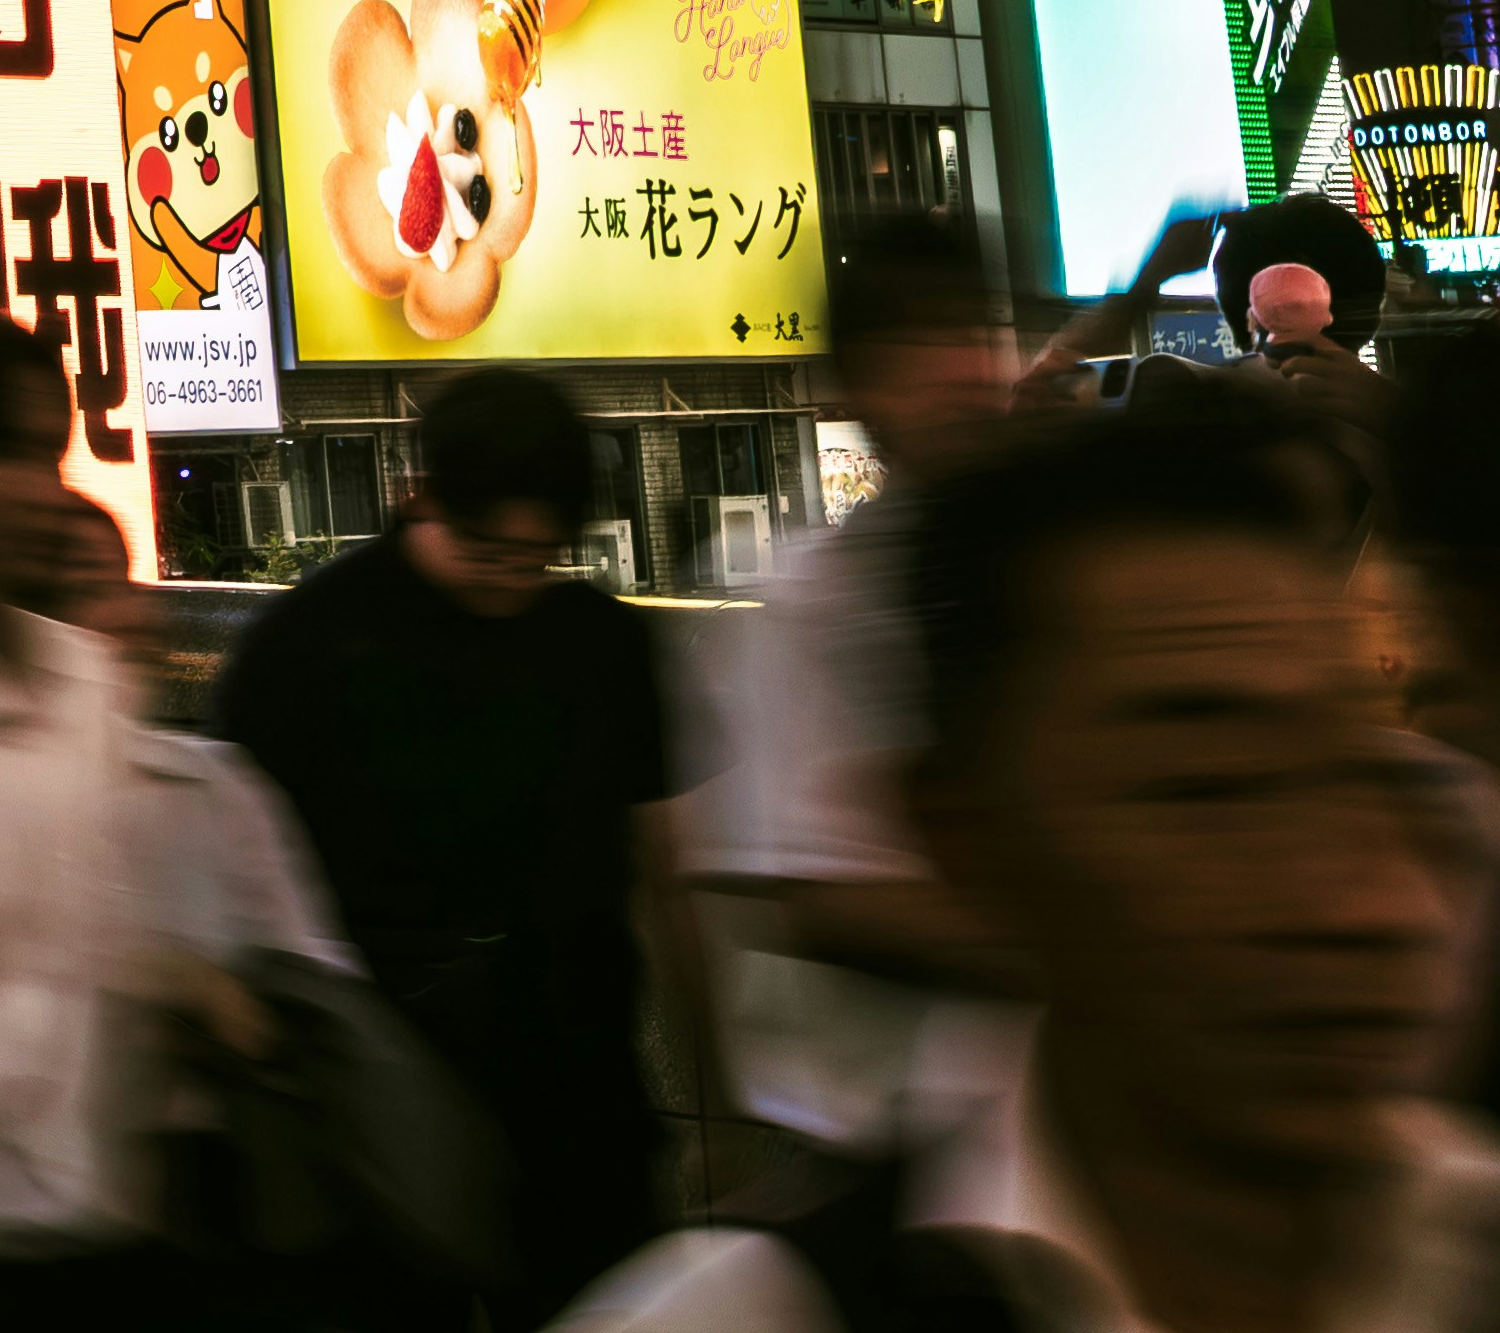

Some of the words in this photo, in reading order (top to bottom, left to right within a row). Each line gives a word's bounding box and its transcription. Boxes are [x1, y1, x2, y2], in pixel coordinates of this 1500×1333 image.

[569, 108, 690, 162] 大阪土産
[578, 195, 631, 241] 大阪
[635, 177, 809, 263] 花ラング
[144, 332, 258, 369] www.jsv.jp
[145, 378, 264, 406] 06-4963-3661
